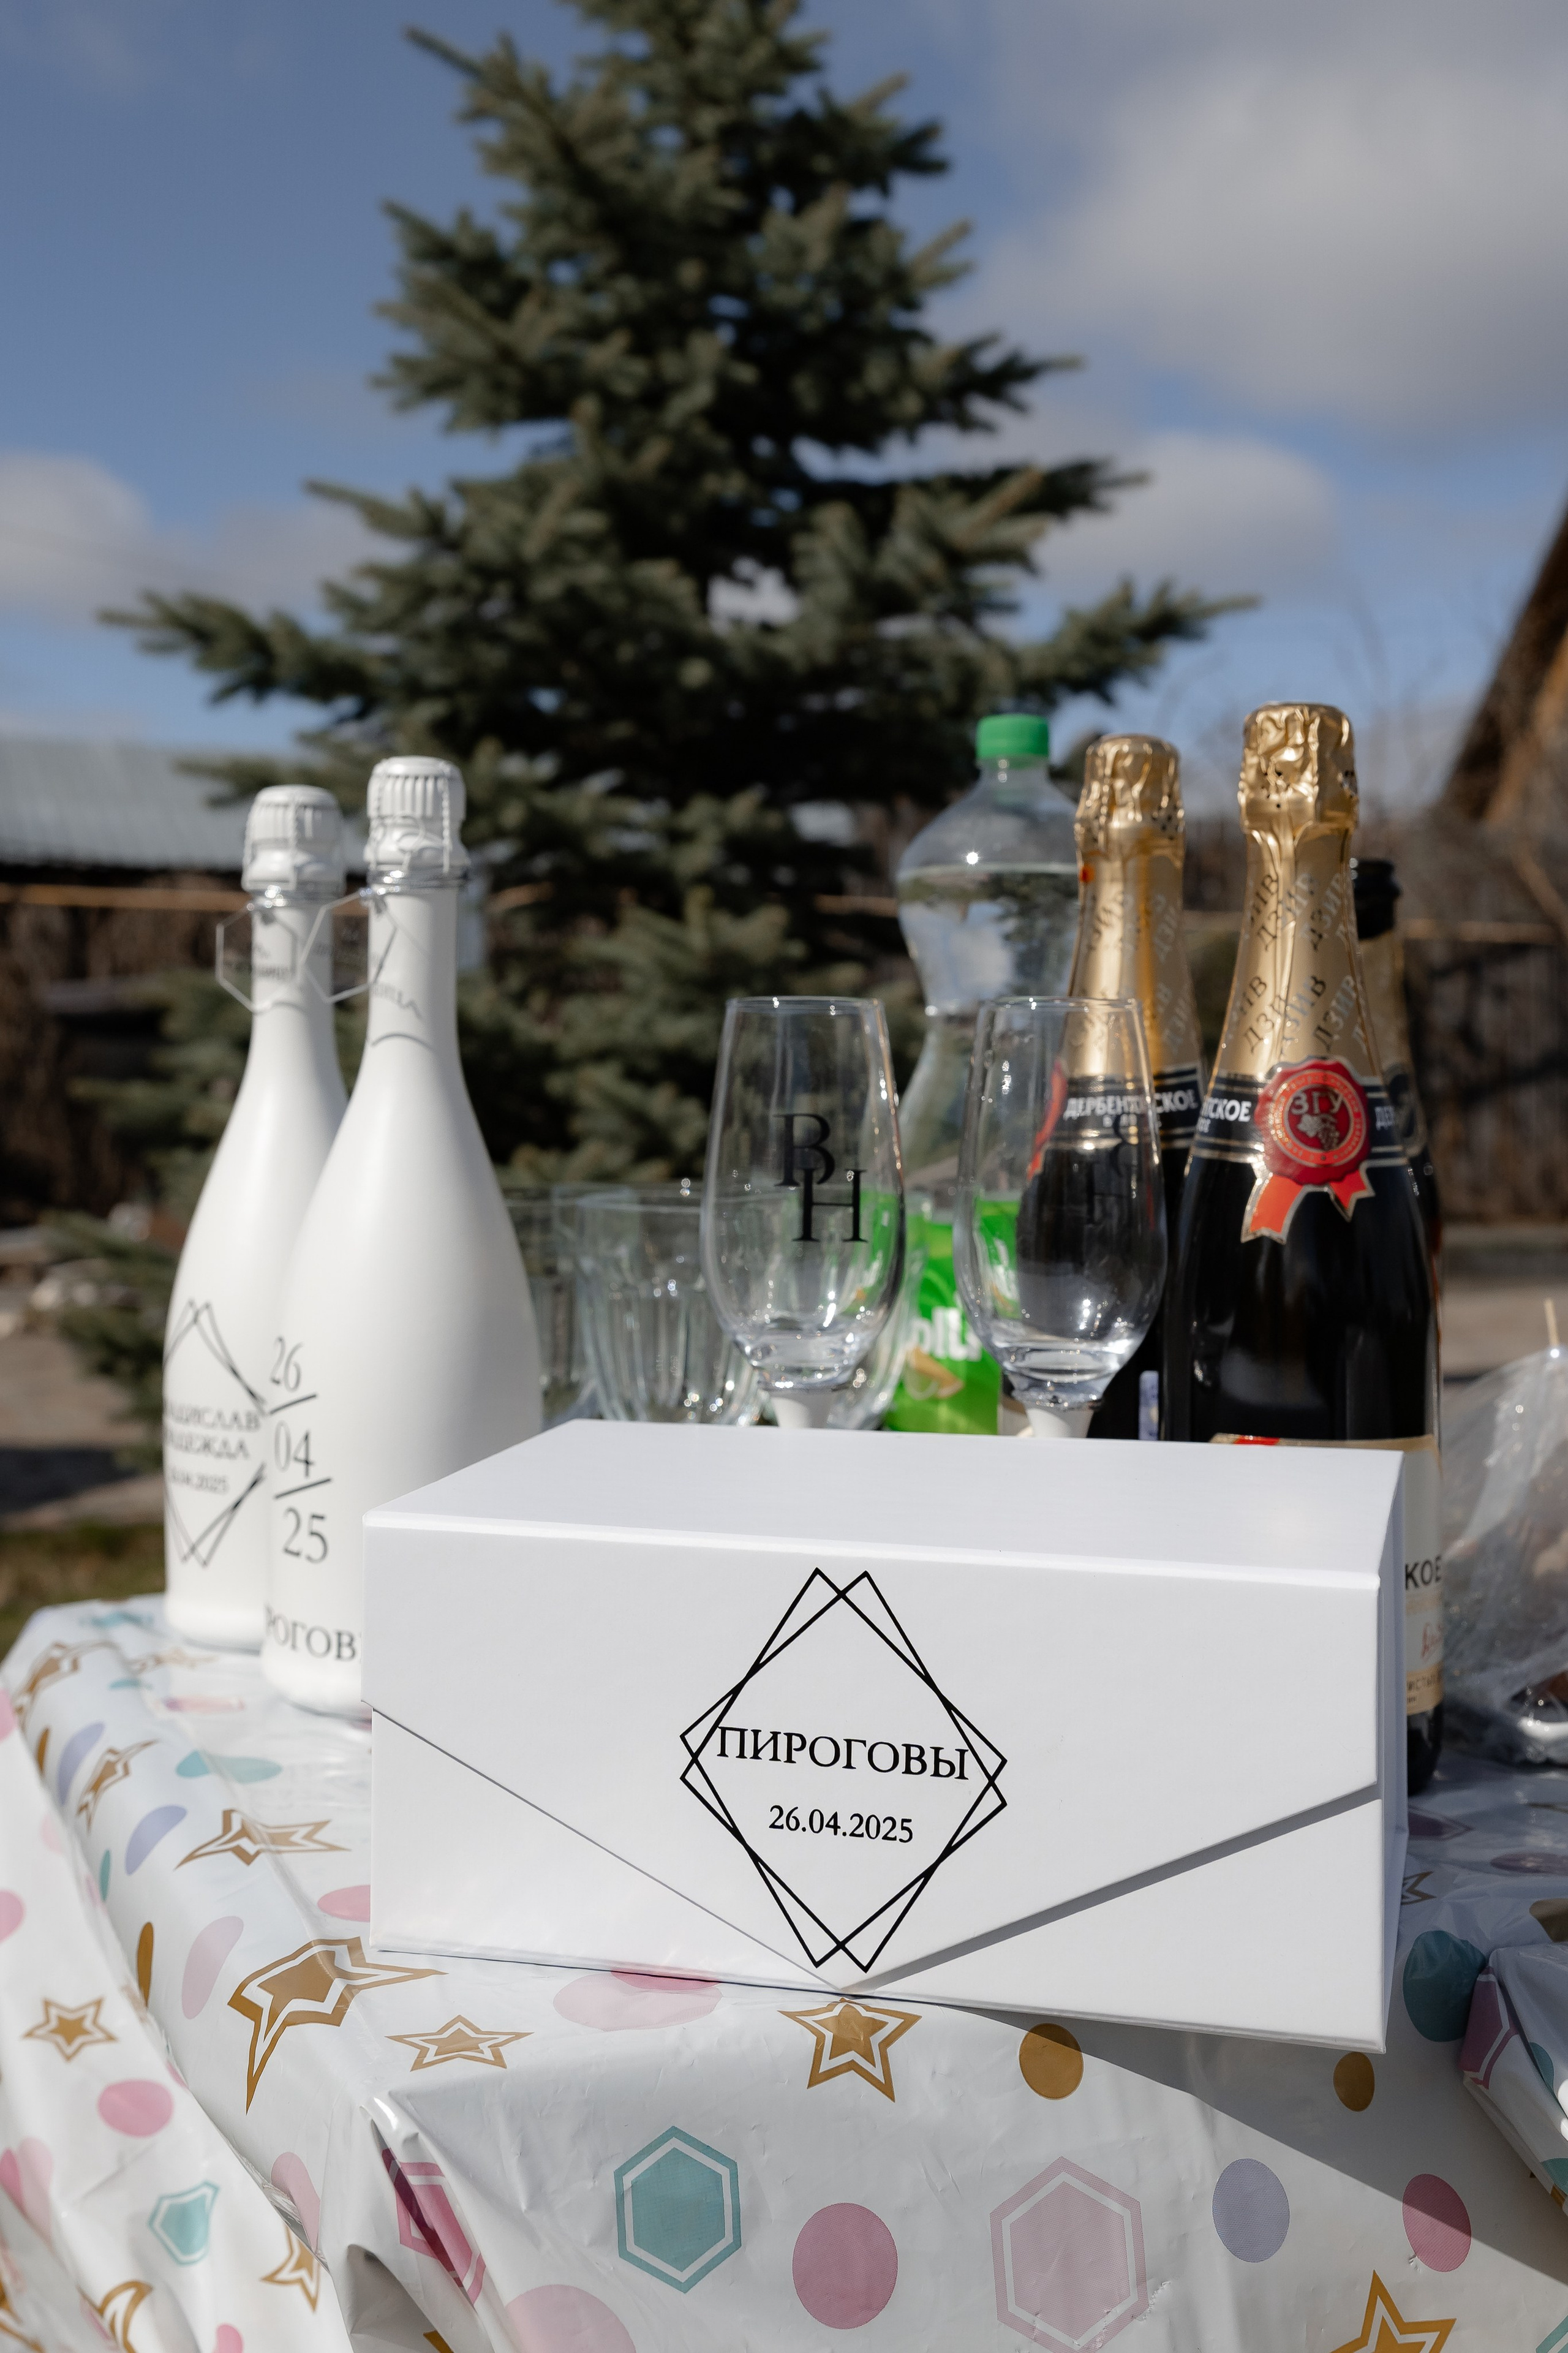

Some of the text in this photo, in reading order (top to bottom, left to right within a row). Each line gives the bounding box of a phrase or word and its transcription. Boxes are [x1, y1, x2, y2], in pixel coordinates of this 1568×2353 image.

[1290, 1090, 1343, 1115] ЗГУ
[270, 1337, 304, 1392] 26
[274, 1420, 315, 1478] 04
[284, 1507, 328, 1563] 25
[717, 1726, 969, 1780] ПИРОГОВЫ
[768, 1804, 913, 1843] 26.04.2025
